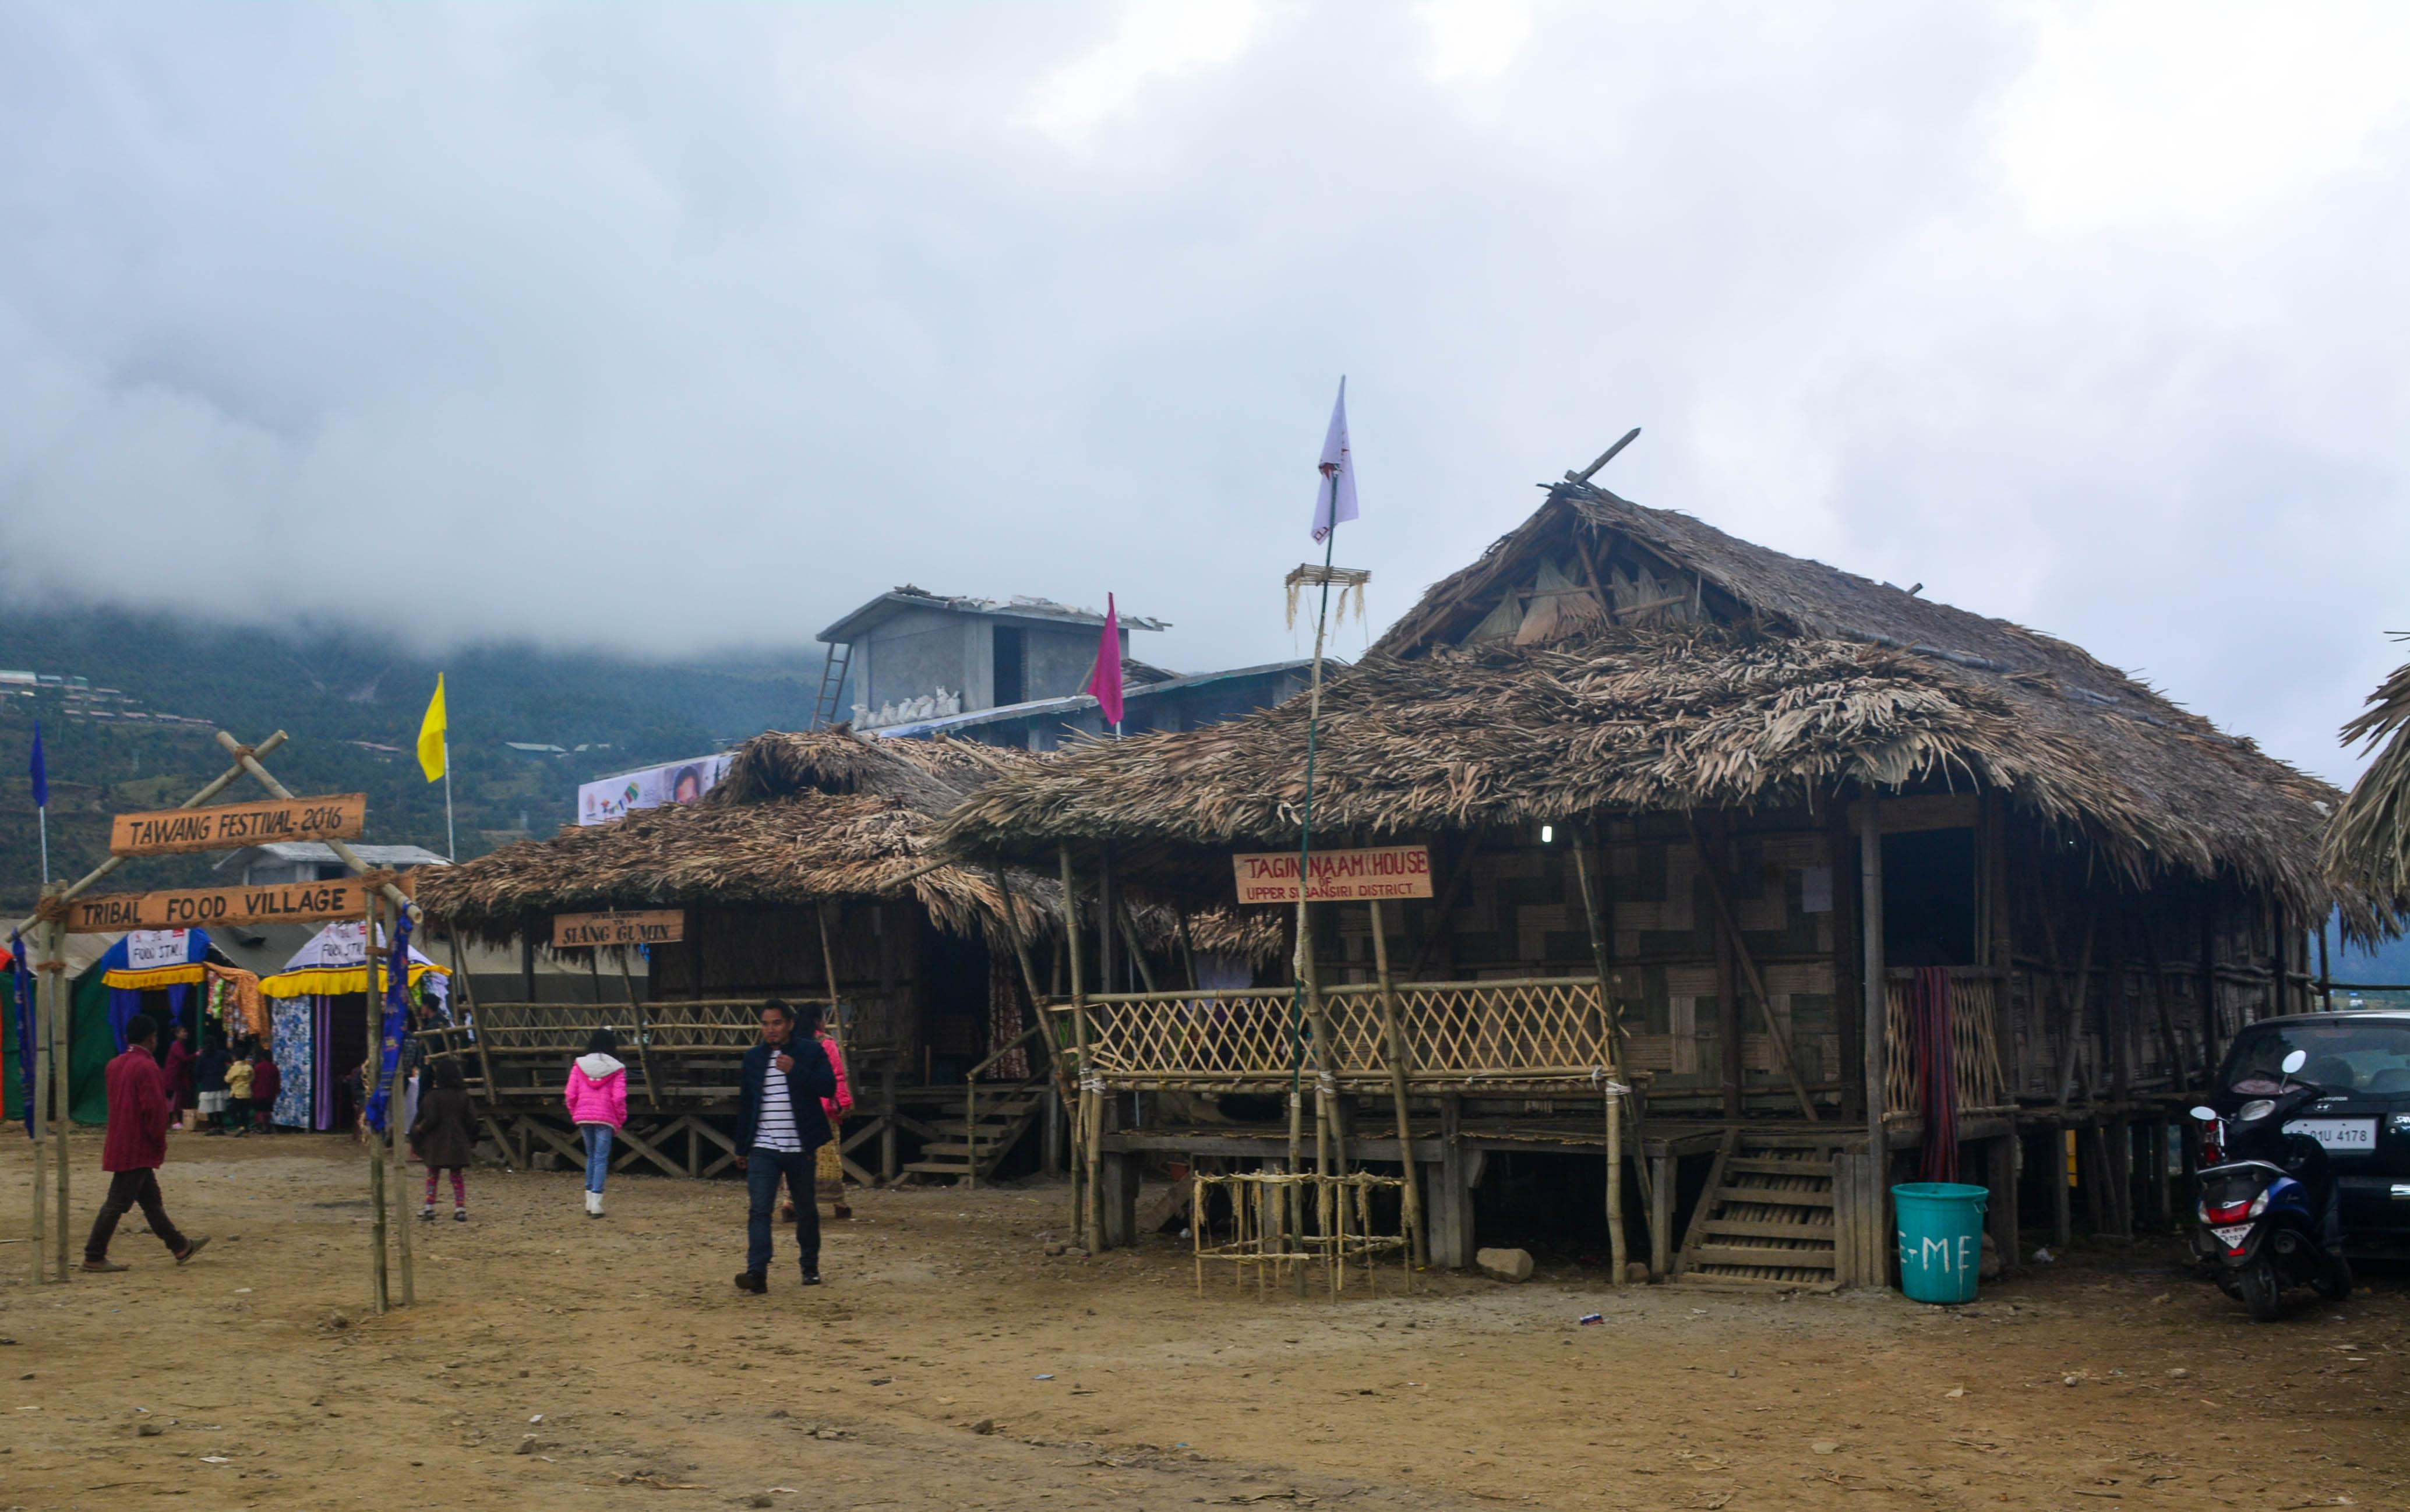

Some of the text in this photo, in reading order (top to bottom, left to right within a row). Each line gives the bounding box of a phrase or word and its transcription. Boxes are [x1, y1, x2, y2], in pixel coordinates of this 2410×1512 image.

[130, 815, 211, 846] TAWANG
[1245, 857, 1301, 879] TAGIN
[1309, 854, 1364, 877] NAAM
[1319, 877, 1332, 888] OF
[1246, 886, 1286, 900] UPPER
[83, 888, 347, 925] TRIBAL FOOD VILLAGE
[2337, 1130, 2367, 1142] 4178
